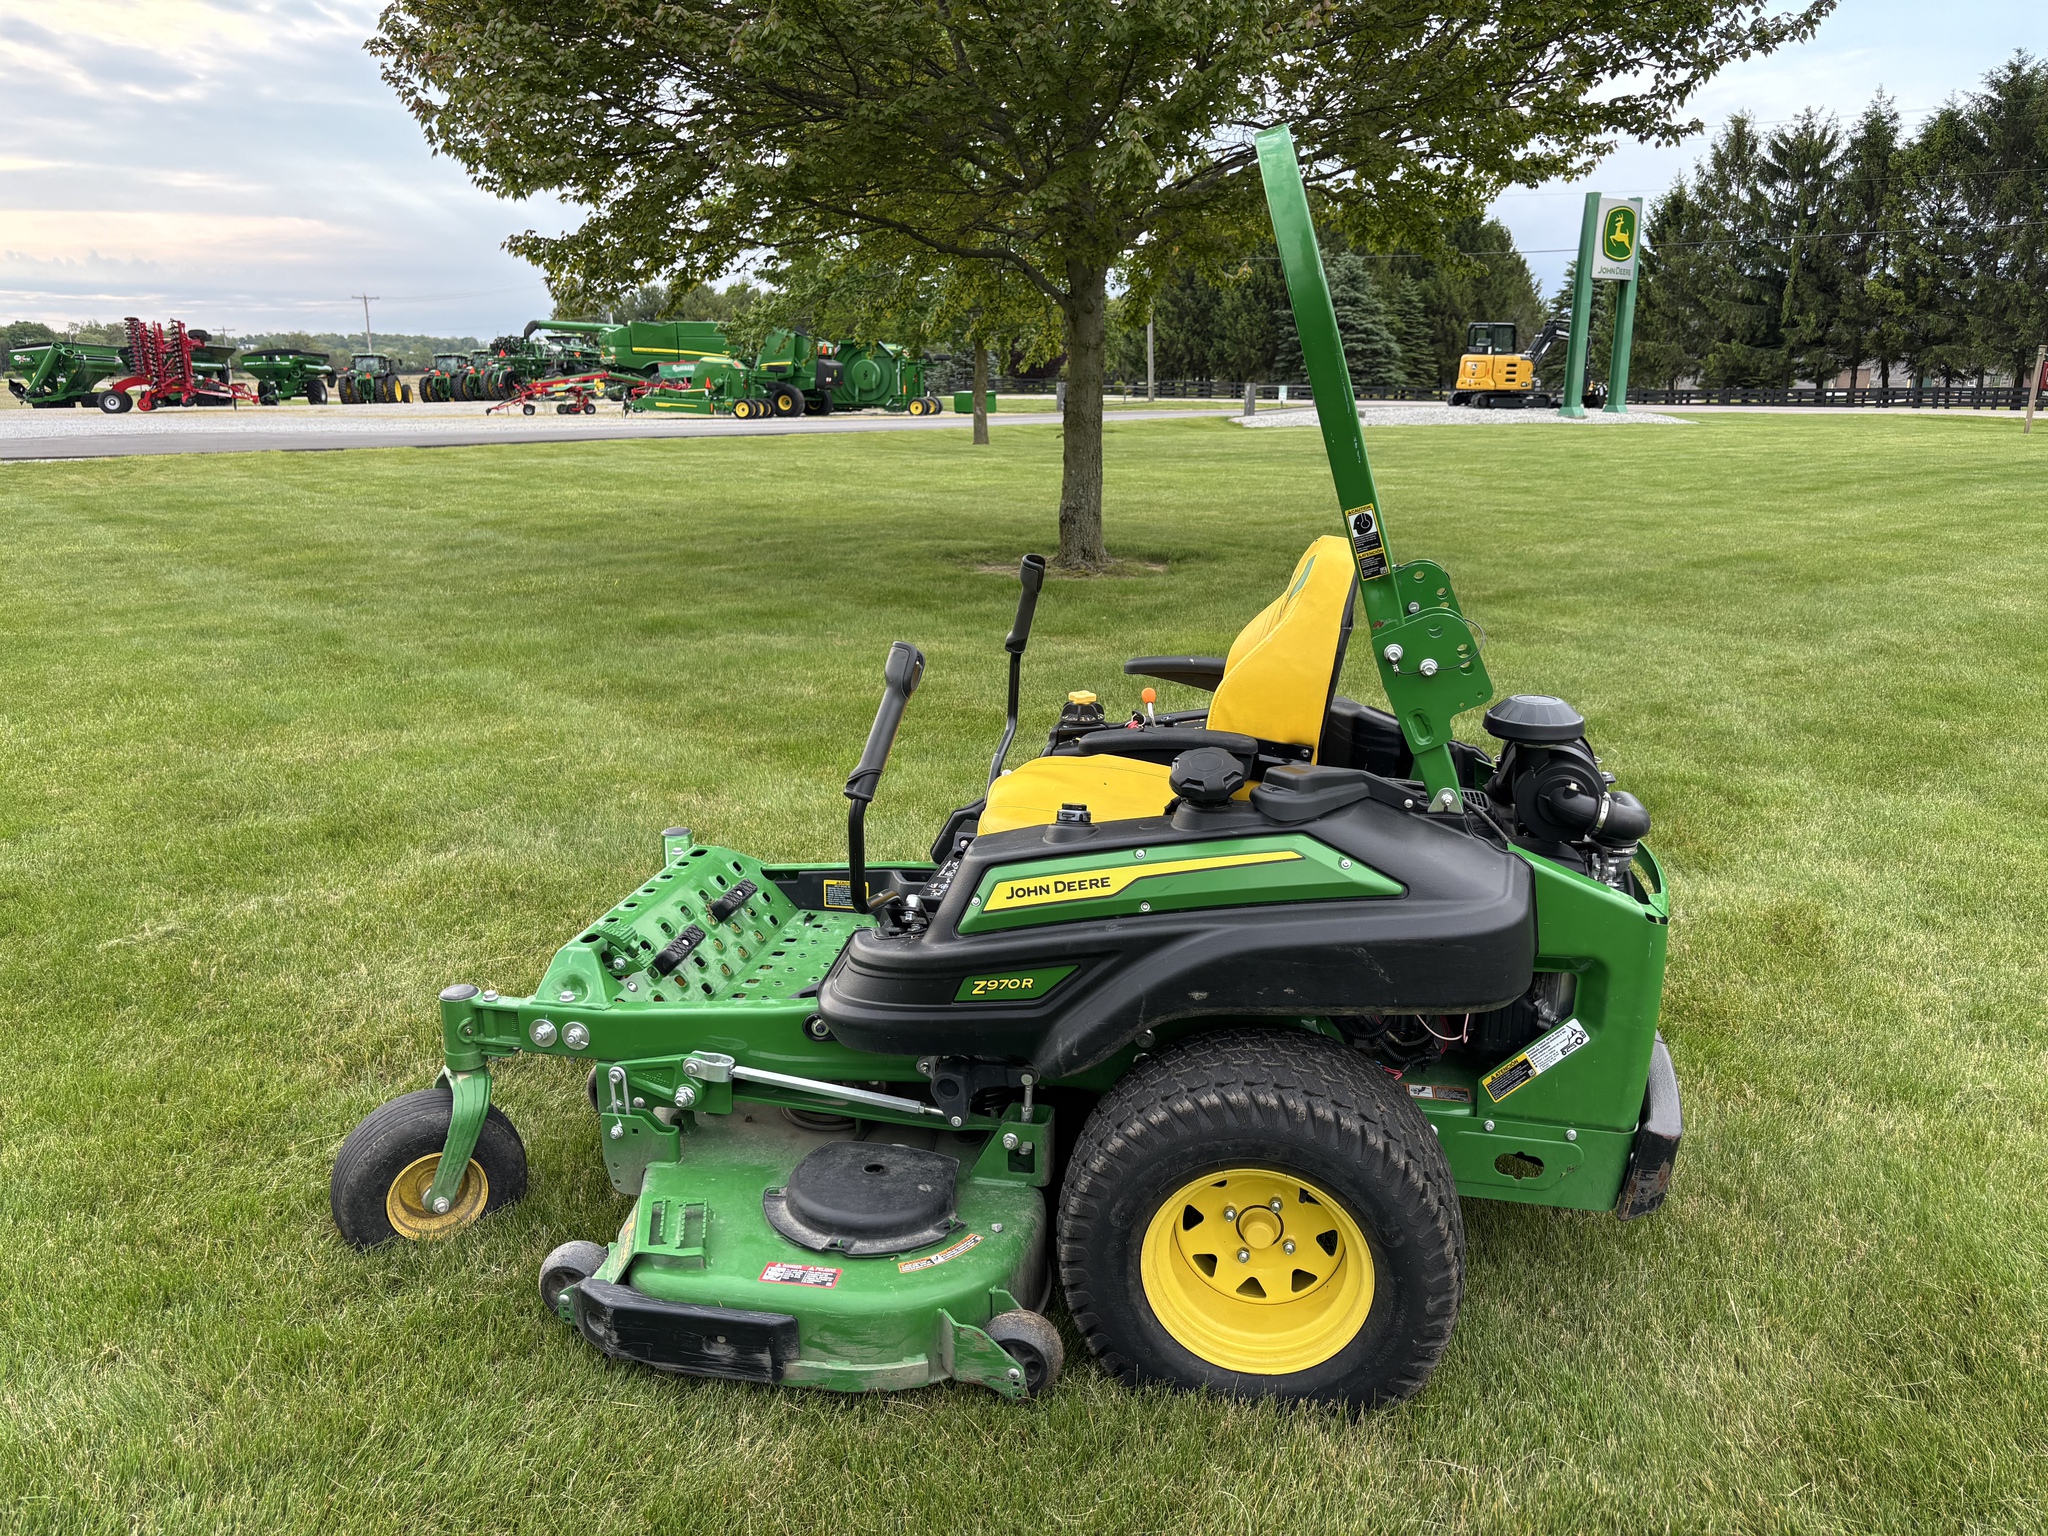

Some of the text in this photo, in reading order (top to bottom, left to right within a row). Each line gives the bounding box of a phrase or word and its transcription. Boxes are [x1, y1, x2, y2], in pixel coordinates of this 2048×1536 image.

[1598, 266, 1631, 276] JOHN DEERE
[1006, 877, 1111, 900] JOHN DEERE
[971, 978, 1034, 995] Z970R
